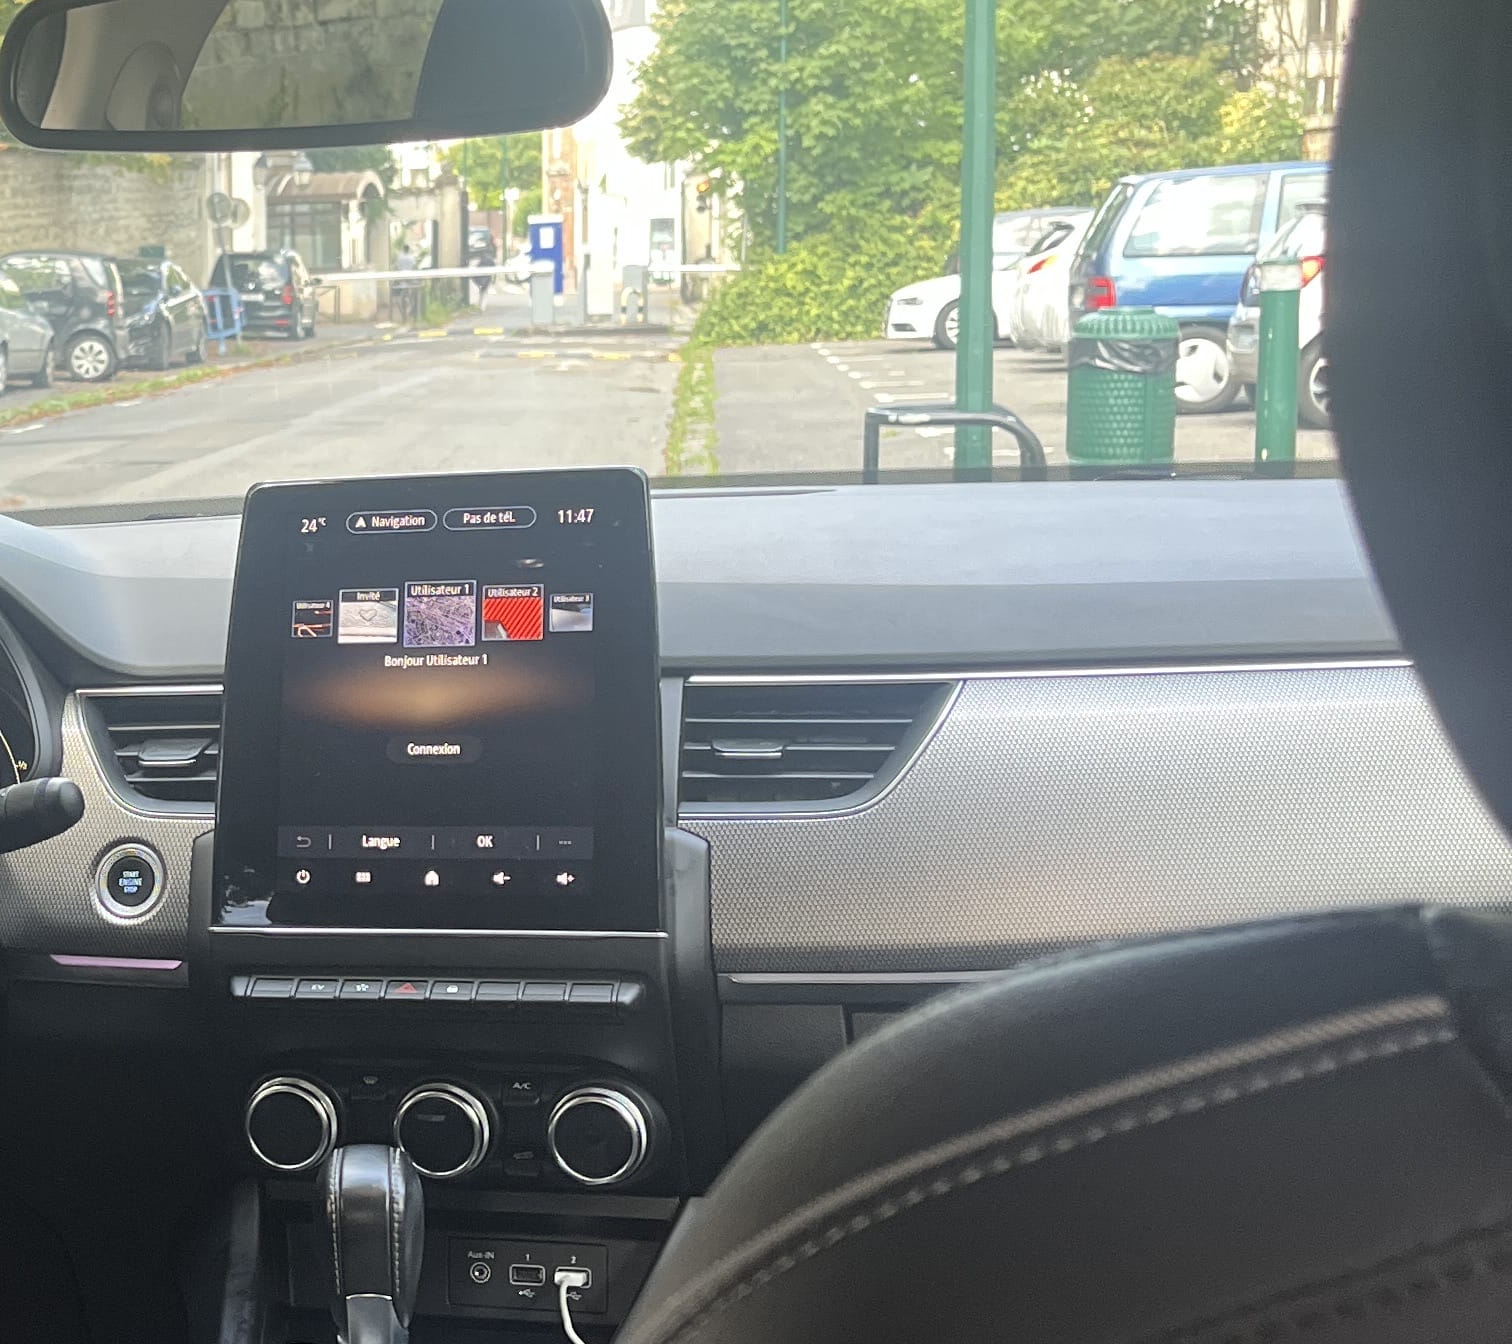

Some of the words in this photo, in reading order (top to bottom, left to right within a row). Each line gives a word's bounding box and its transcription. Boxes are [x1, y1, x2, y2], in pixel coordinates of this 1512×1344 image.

[371, 515, 426, 529] Navigation
[463, 512, 482, 524] Pas
[483, 512, 497, 524] de
[557, 508, 595, 524] 11:47
[356, 591, 381, 601] Invité
[410, 583, 462, 596] Utilisateur
[464, 583, 470, 595] 1
[488, 587, 531, 597] Utilisateur
[532, 587, 539, 597] 2
[384, 655, 424, 669] Bonjour
[426, 654, 480, 666] Utilisateur
[482, 654, 488, 665] 1
[407, 743, 461, 756] Connexion
[362, 835, 401, 850] Langue
[476, 835, 494, 848] OK
[512, 1081, 533, 1090] A/C
[525, 1253, 530, 1262] 1
[570, 1256, 577, 1264] 2
